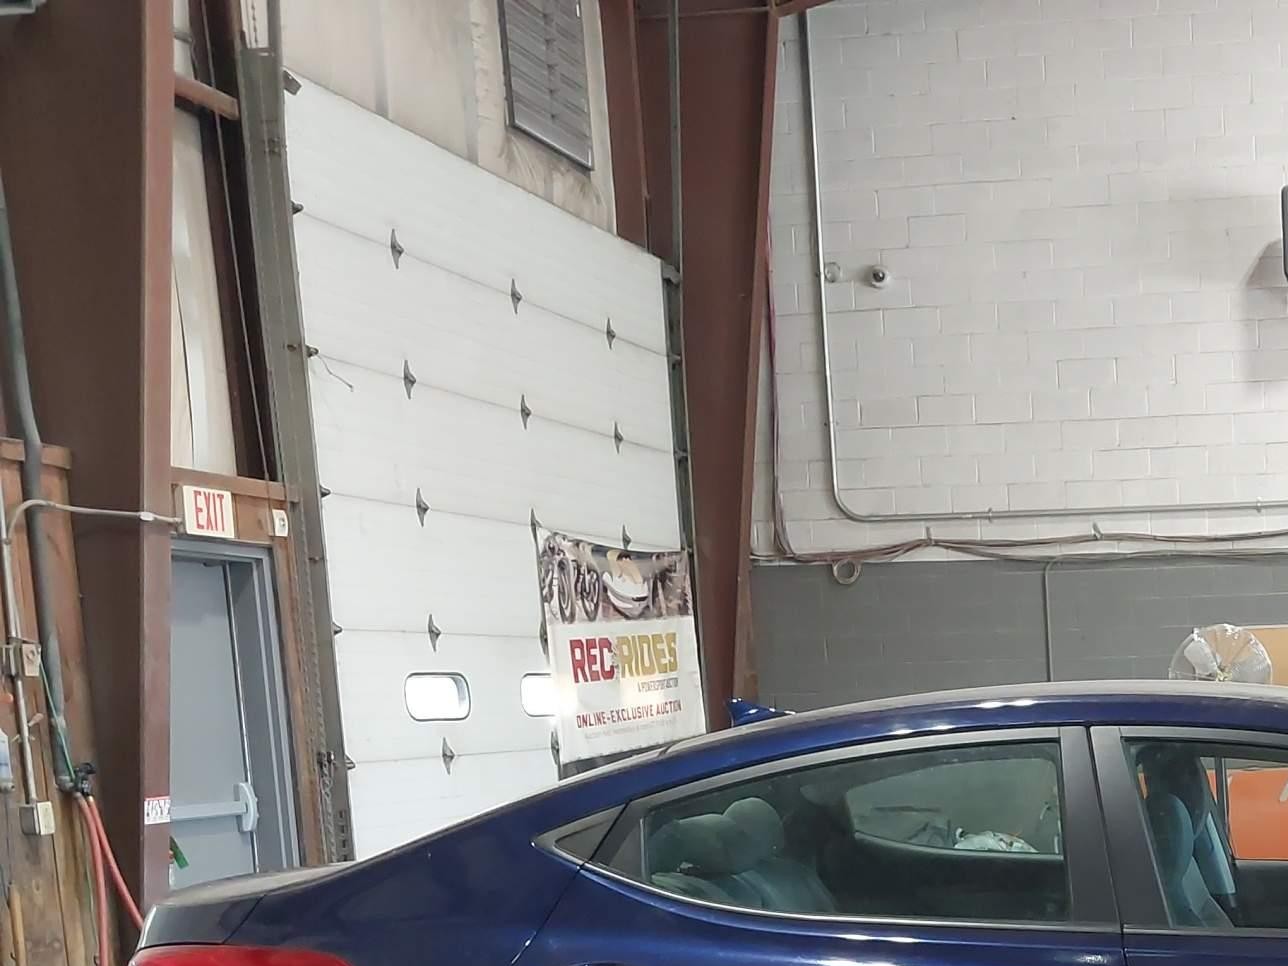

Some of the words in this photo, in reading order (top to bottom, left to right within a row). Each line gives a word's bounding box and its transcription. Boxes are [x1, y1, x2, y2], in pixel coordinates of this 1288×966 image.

[193, 490, 225, 532] EXIT
[569, 637, 615, 683] REC
[616, 632, 678, 678] RIDES
[576, 705, 654, 728] ONLINE-EXCLUSIVE
[656, 700, 682, 716] AUCTION
